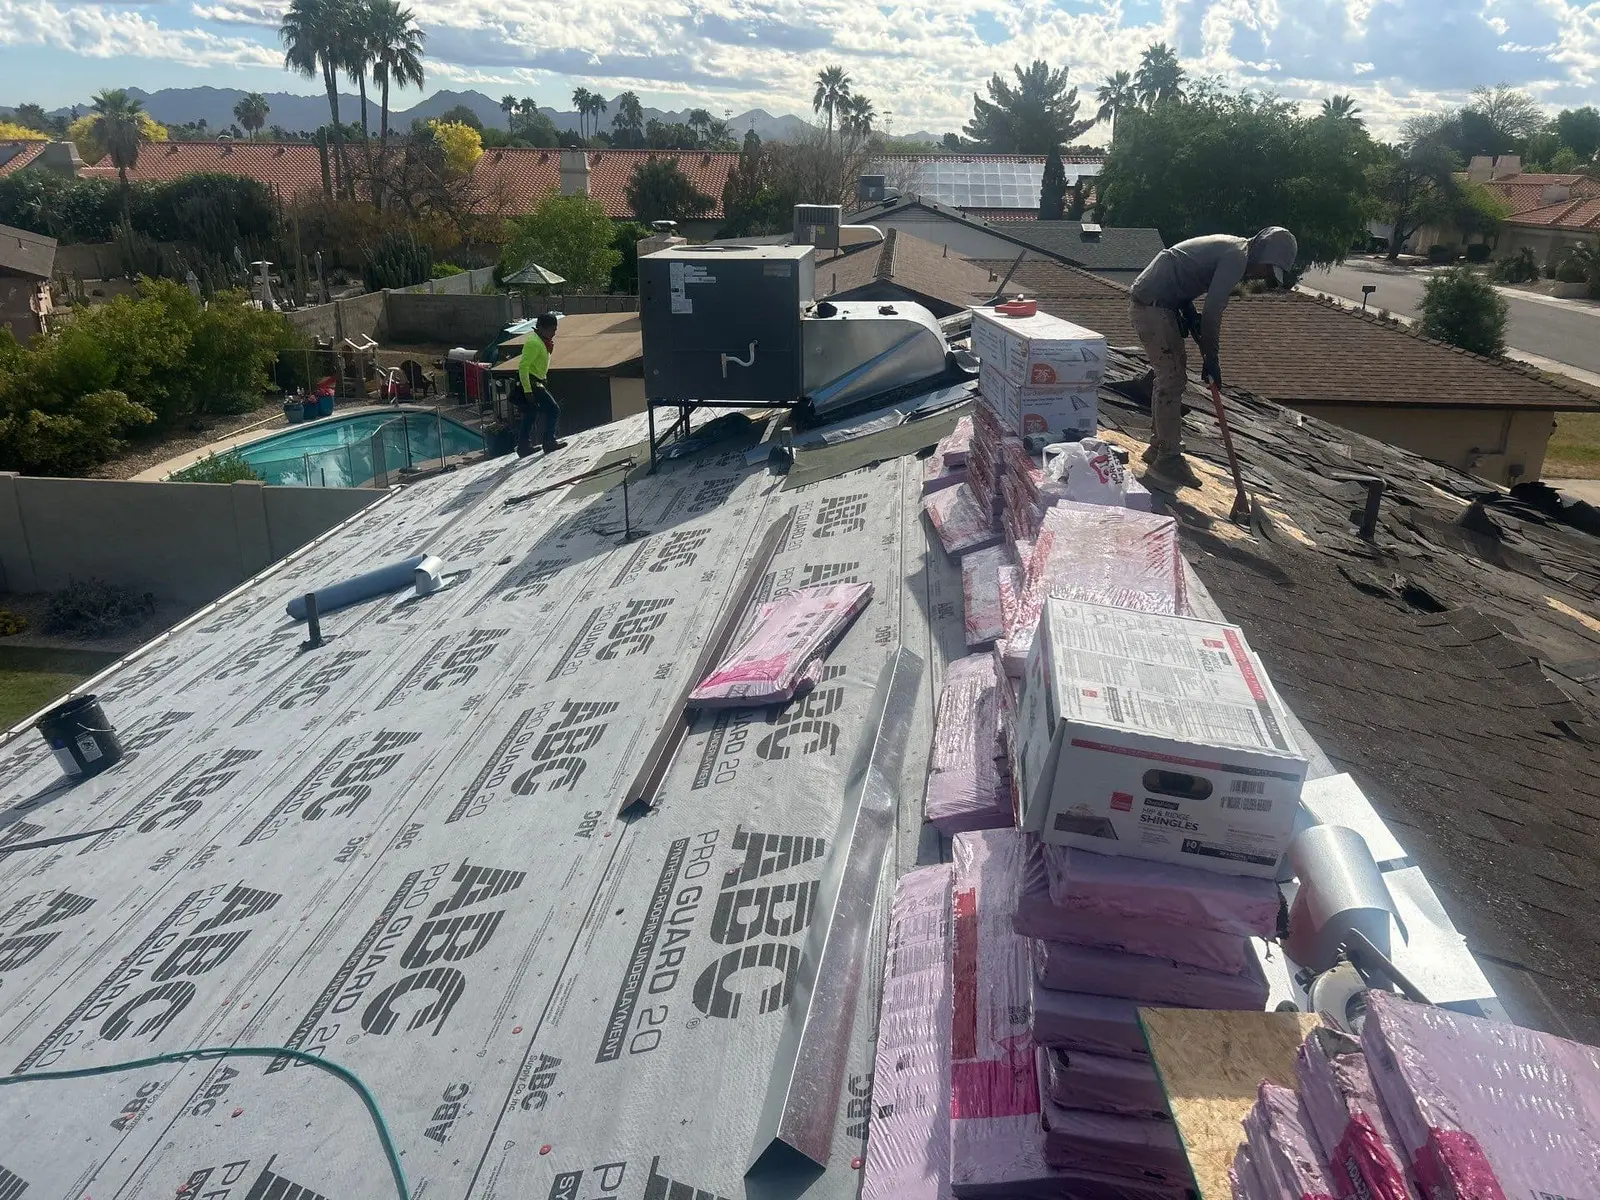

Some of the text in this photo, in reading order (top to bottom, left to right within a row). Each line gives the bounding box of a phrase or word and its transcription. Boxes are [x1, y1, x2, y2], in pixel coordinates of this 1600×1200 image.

[812, 493, 868, 538] ABC
[423, 626, 511, 691] ABC
[595, 598, 675, 660] ABC
[301, 727, 423, 821] ABC
[465, 701, 555, 818] PRO GUARD 20
[511, 698, 620, 796] ABC
[715, 758, 740, 784] 20
[137, 746, 262, 833] ABC
[283, 761, 343, 814] GUARD
[1165, 811, 1191, 822] RIDGE
[257, 818, 288, 841] 20
[333, 837, 364, 863] ABC
[395, 822, 425, 850] ABC
[574, 811, 602, 839] ABC
[1140, 814, 1199, 831] SHINGLES
[403, 862, 450, 909] PRO
[361, 856, 527, 1036] ABC
[603, 839, 686, 1058] SYNTHETIC ROOFING UNDERLAYMENT
[630, 829, 719, 1055] PRO GUARD 20
[693, 824, 825, 1019] ABC
[35, 883, 227, 1068] PRO GUARD 20
[100, 880, 283, 1042] ABC
[332, 915, 414, 1014] GUARD
[192, 1065, 240, 1117] ABC
[515, 1083, 526, 1097] Co.
[519, 1055, 538, 1085] Supply
[521, 1052, 562, 1111] ABC
[110, 1081, 160, 1132] ABC
[424, 1082, 469, 1146] ABC
